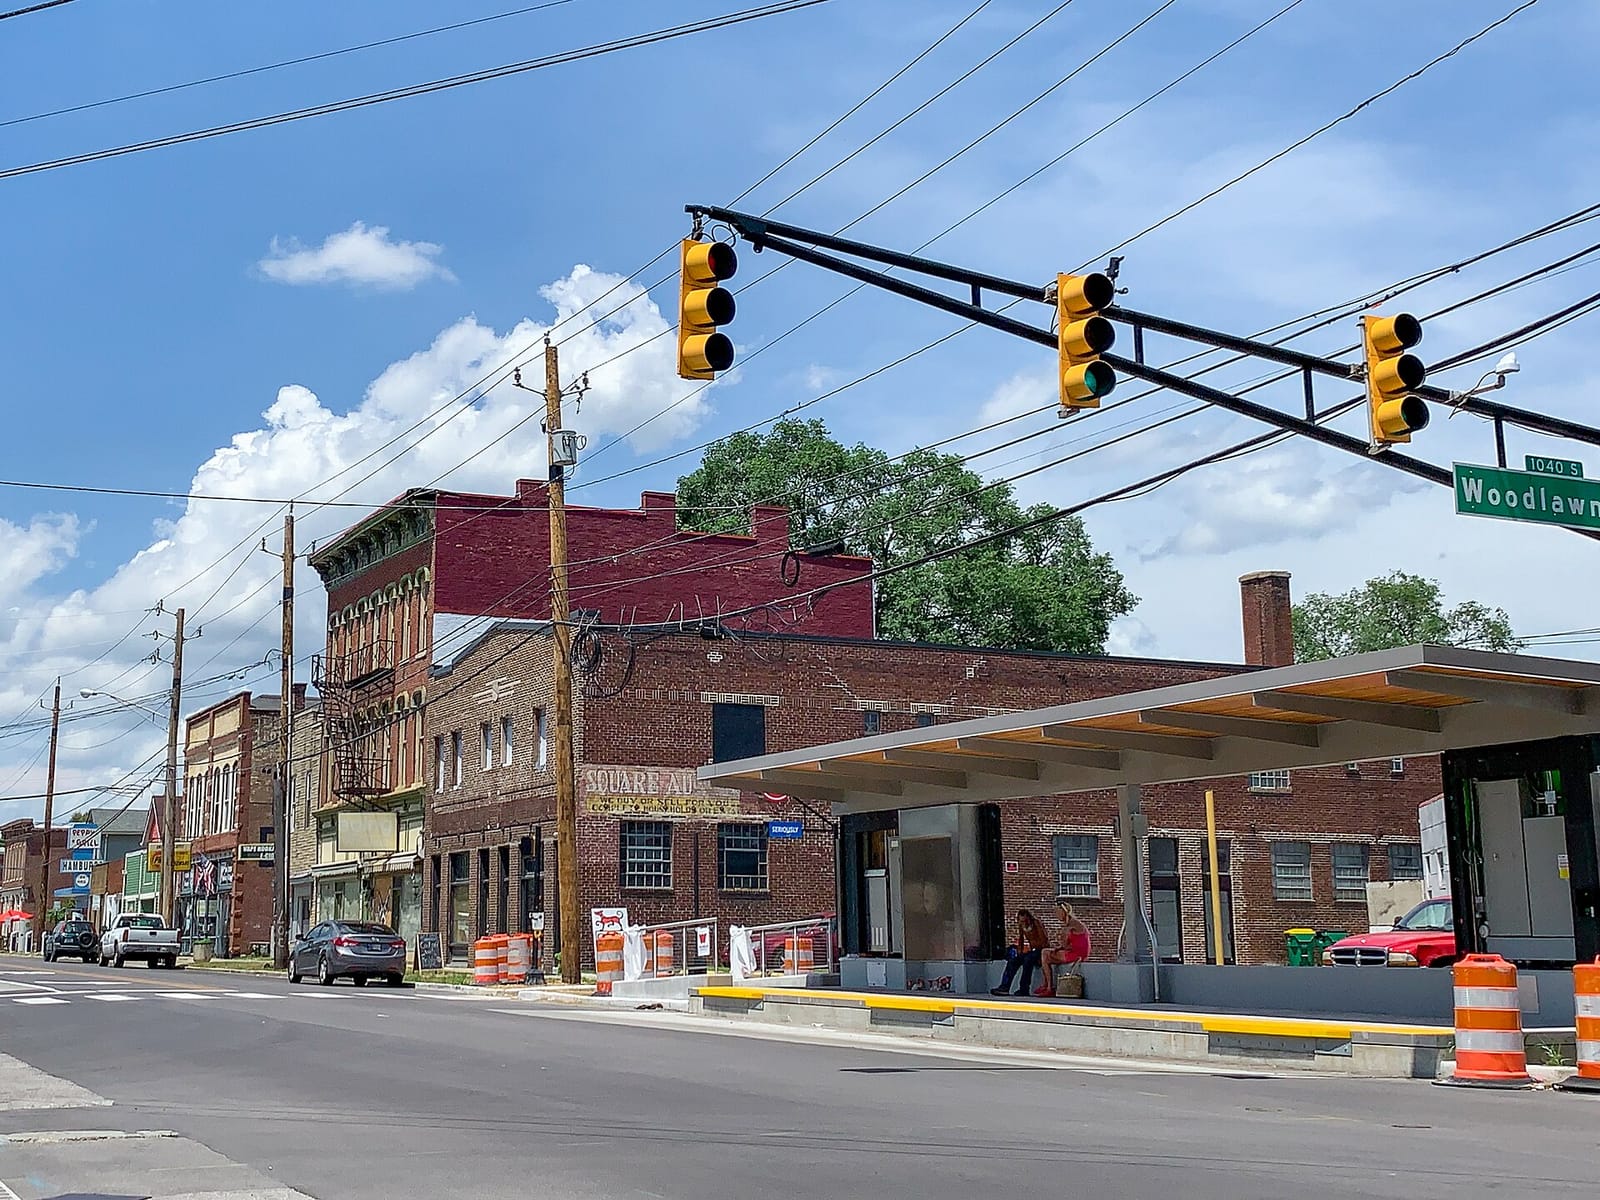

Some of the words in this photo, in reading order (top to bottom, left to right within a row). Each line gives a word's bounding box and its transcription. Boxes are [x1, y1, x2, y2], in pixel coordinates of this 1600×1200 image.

[1531, 457, 1564, 474] 1040
[1570, 463, 1579, 476] S
[1461, 476, 1600, 518] Woodlawn
[586, 769, 659, 796] SQUARE
[771, 826, 799, 834] SERIOUSLY
[62, 860, 103, 871] HAMBUR
